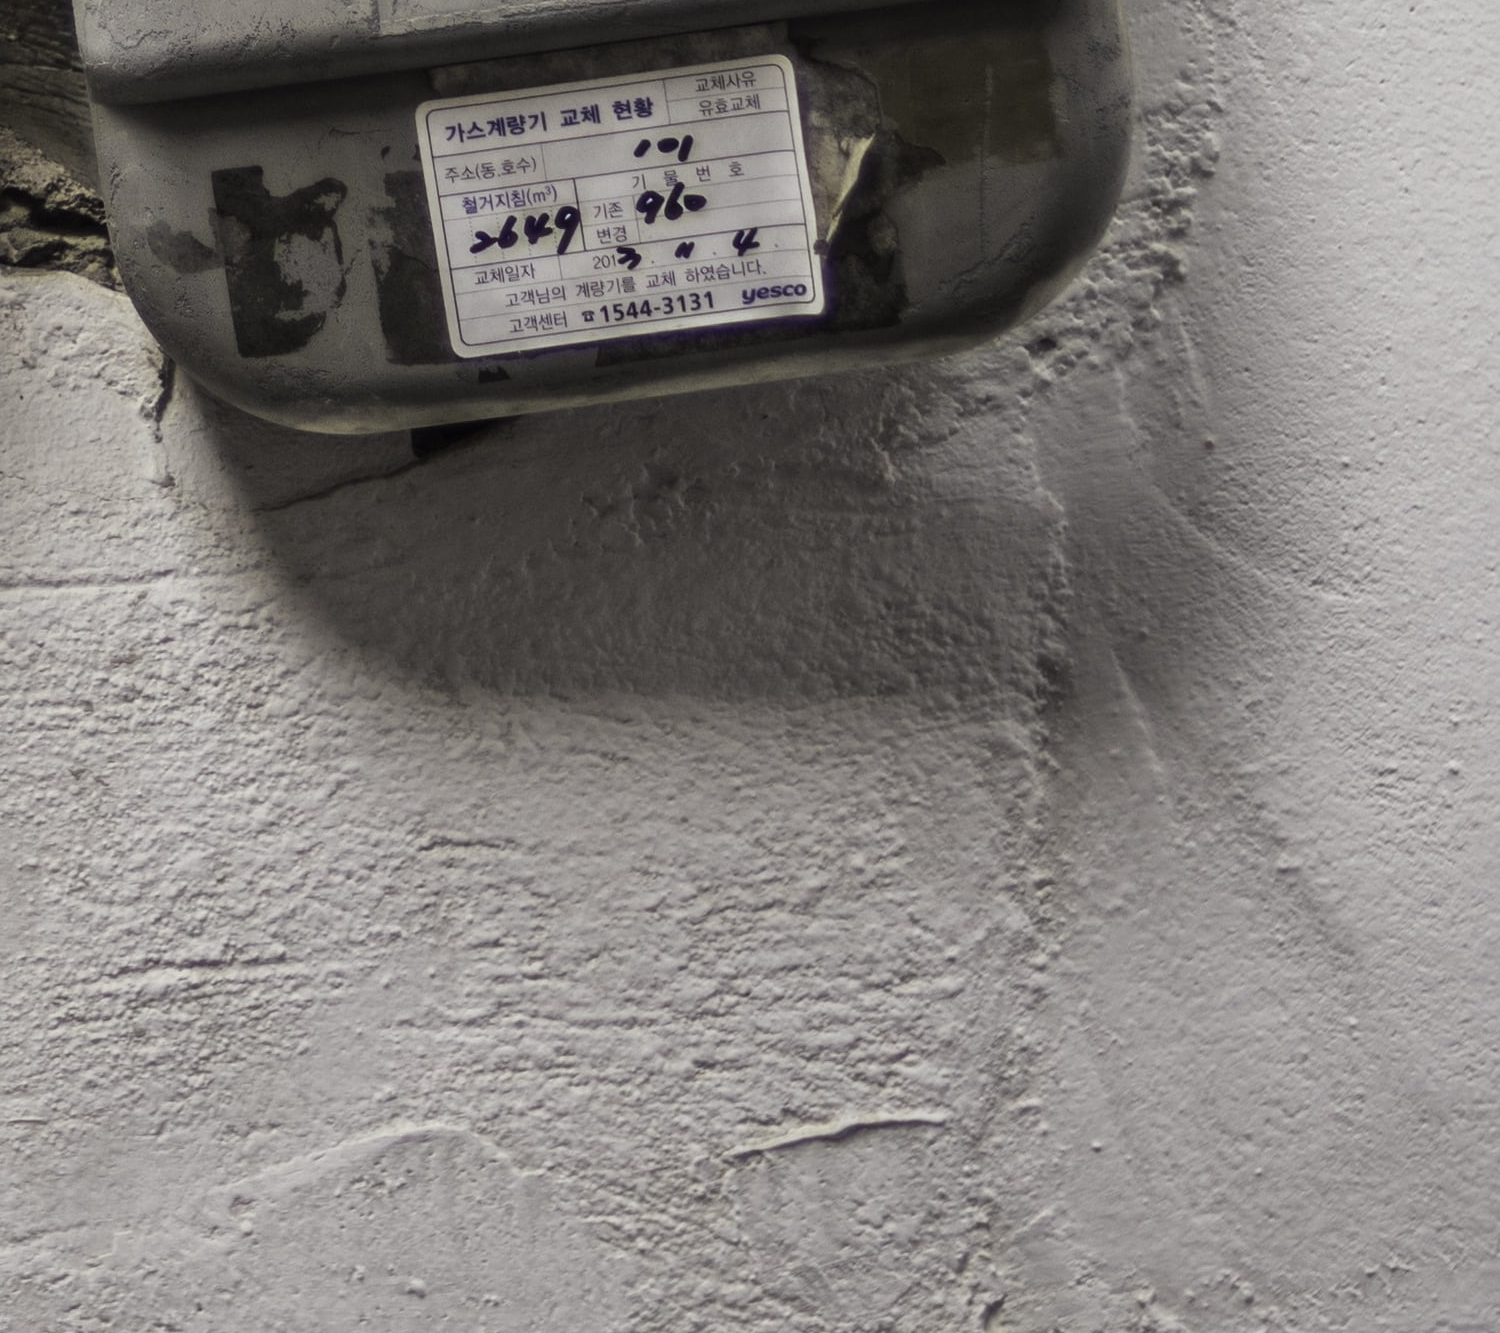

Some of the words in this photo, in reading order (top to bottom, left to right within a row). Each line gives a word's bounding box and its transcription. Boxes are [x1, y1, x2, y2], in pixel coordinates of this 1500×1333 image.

[695, 71, 757, 93] 교체사유
[698, 94, 761, 117] 유효교체
[445, 110, 548, 144] 가스계량기
[560, 104, 601, 129] 교체
[612, 97, 655, 120] 현황
[593, 201, 625, 220] 기존
[596, 224, 628, 244] 변경
[474, 264, 536, 286] 교체일자
[504, 286, 567, 309] 고객님의
[575, 278, 637, 301] 계량기를
[646, 269, 678, 290] 교체
[685, 260, 768, 287] 하였습니다.
[741, 282, 808, 307] yesco
[508, 314, 569, 334] 고객센터
[600, 290, 716, 323] 1544-3131
